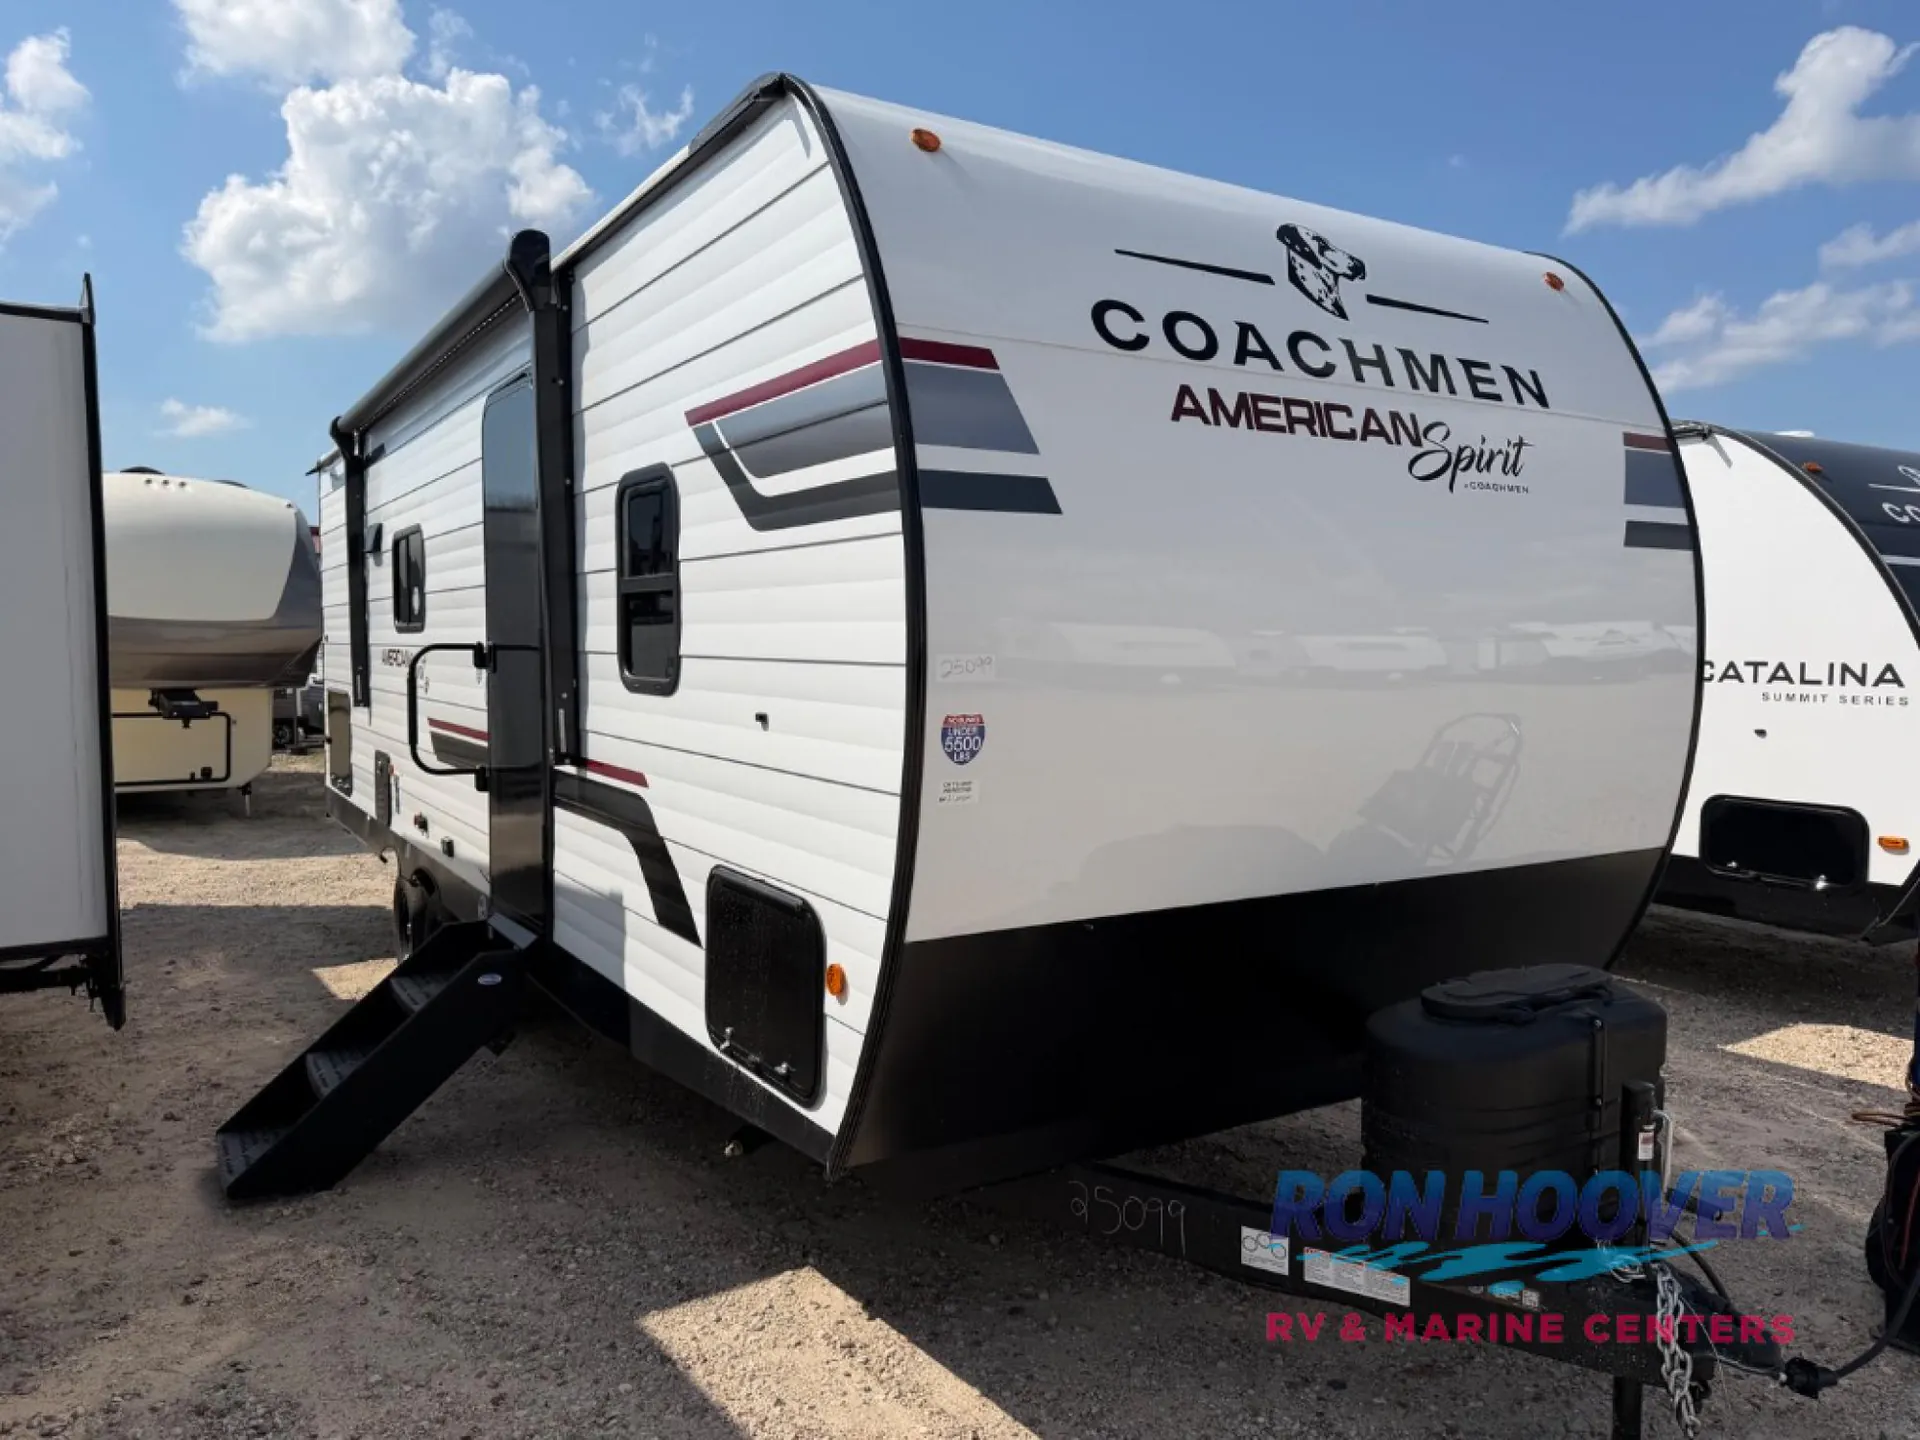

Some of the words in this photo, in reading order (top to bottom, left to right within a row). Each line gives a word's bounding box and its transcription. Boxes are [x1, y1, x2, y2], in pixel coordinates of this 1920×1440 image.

[1091, 299, 1550, 409] COACHMEN
[1171, 384, 1422, 447] AMERICAN
[1408, 421, 1535, 493] Spirit
[1469, 481, 1529, 494] COACHMEN
[940, 656, 993, 679] 25099
[1762, 692, 1829, 703] SUMMIT
[1839, 694, 1908, 706] SERIES
[1068, 1180, 1186, 1255] 25099
